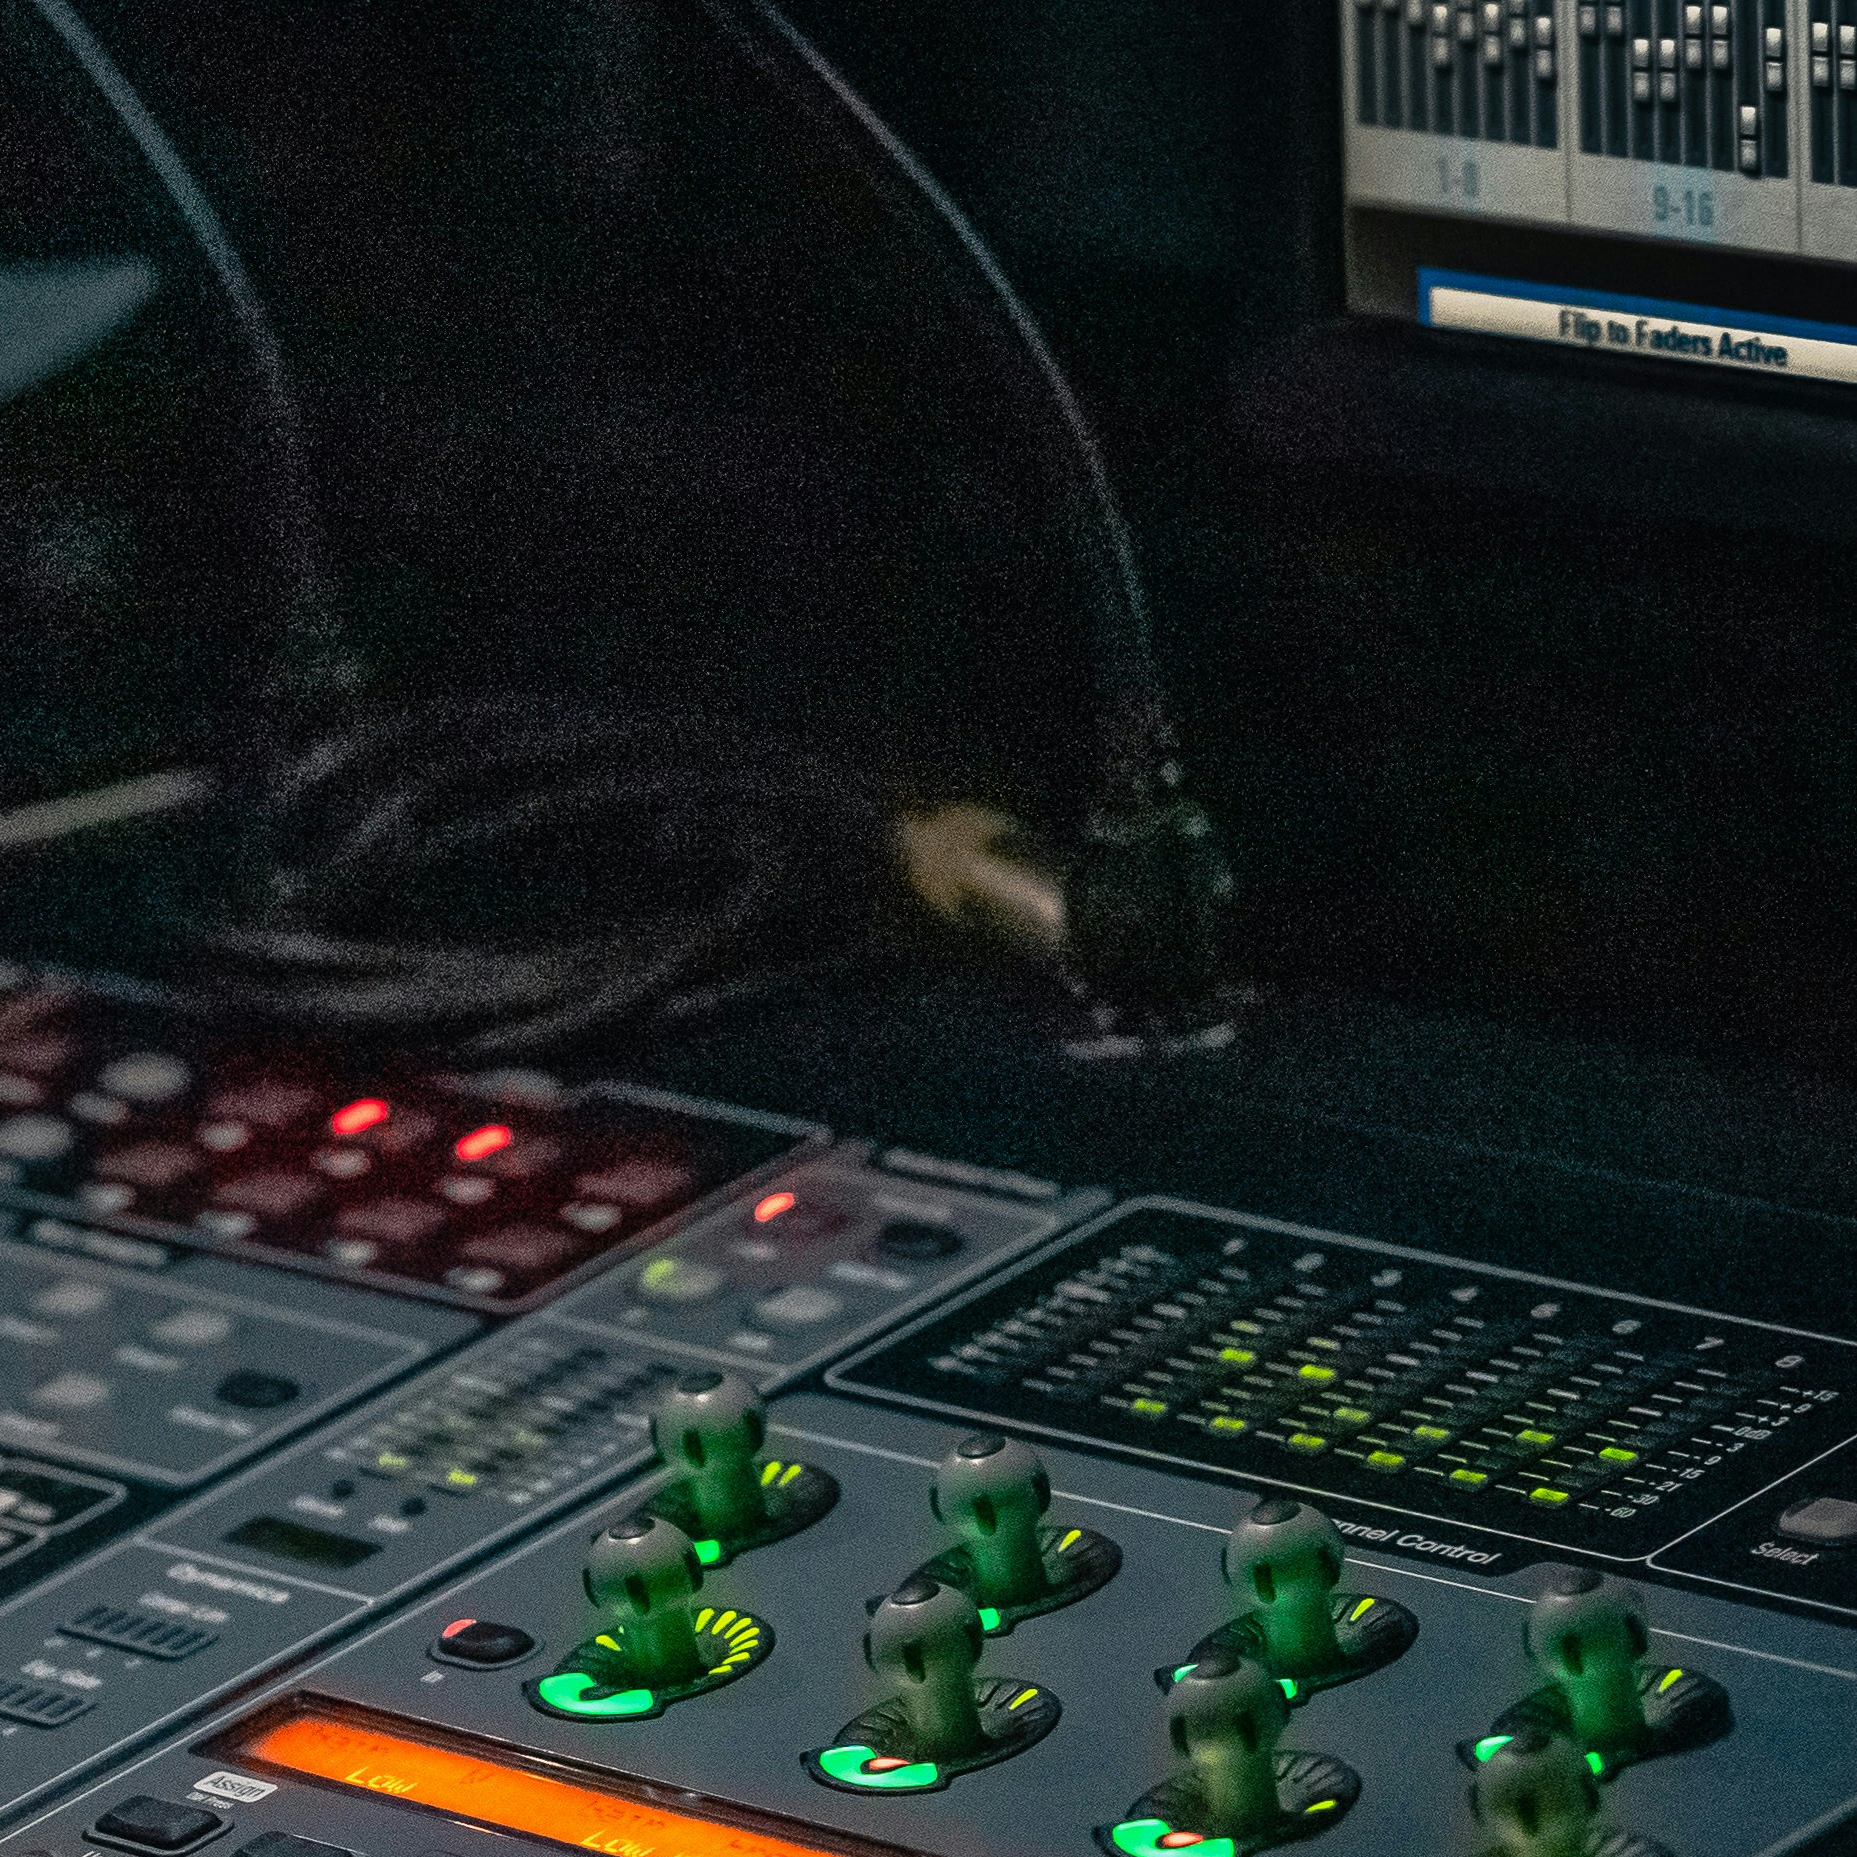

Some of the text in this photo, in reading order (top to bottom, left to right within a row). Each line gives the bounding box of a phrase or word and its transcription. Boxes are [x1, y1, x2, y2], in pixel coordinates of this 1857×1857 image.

[1652, 182, 1714, 228] 9-16
[1558, 309, 1788, 366] Flip to Faders Active
[1397, 1535, 1502, 1564] Control
[1751, 1542, 1819, 1566] Select
[211, 1775, 266, 1799] Assign
